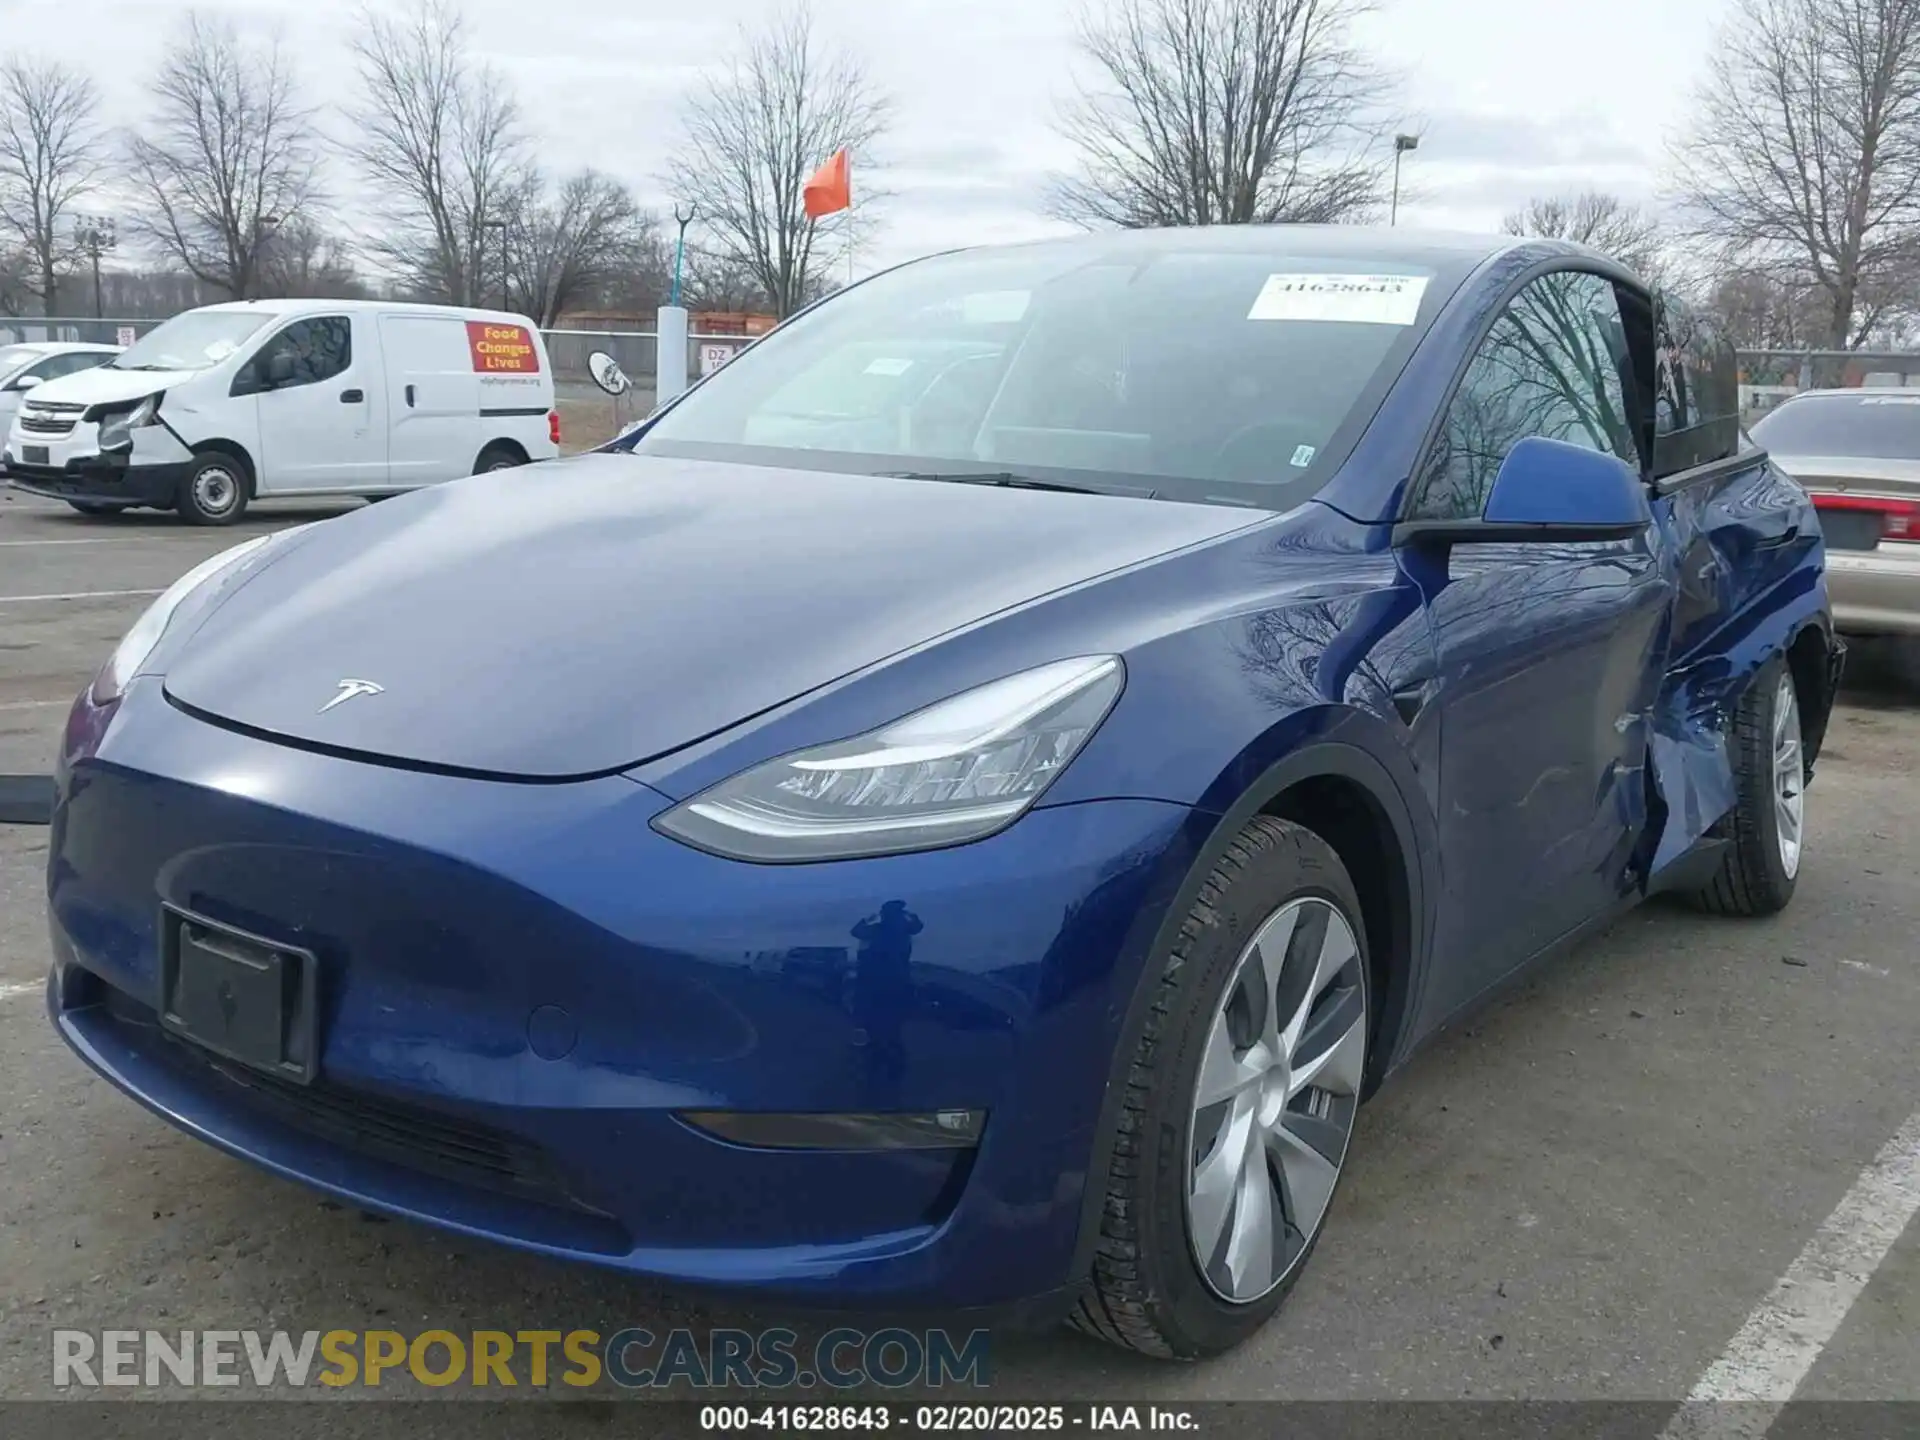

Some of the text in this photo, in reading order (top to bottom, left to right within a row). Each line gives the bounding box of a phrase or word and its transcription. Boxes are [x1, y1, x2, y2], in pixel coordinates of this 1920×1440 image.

[1279, 283, 1403, 293] 41628643
[484, 327, 519, 339] Food
[476, 341, 531, 357] Changes
[708, 349, 726, 361] DZ
[485, 356, 521, 369] Lives
